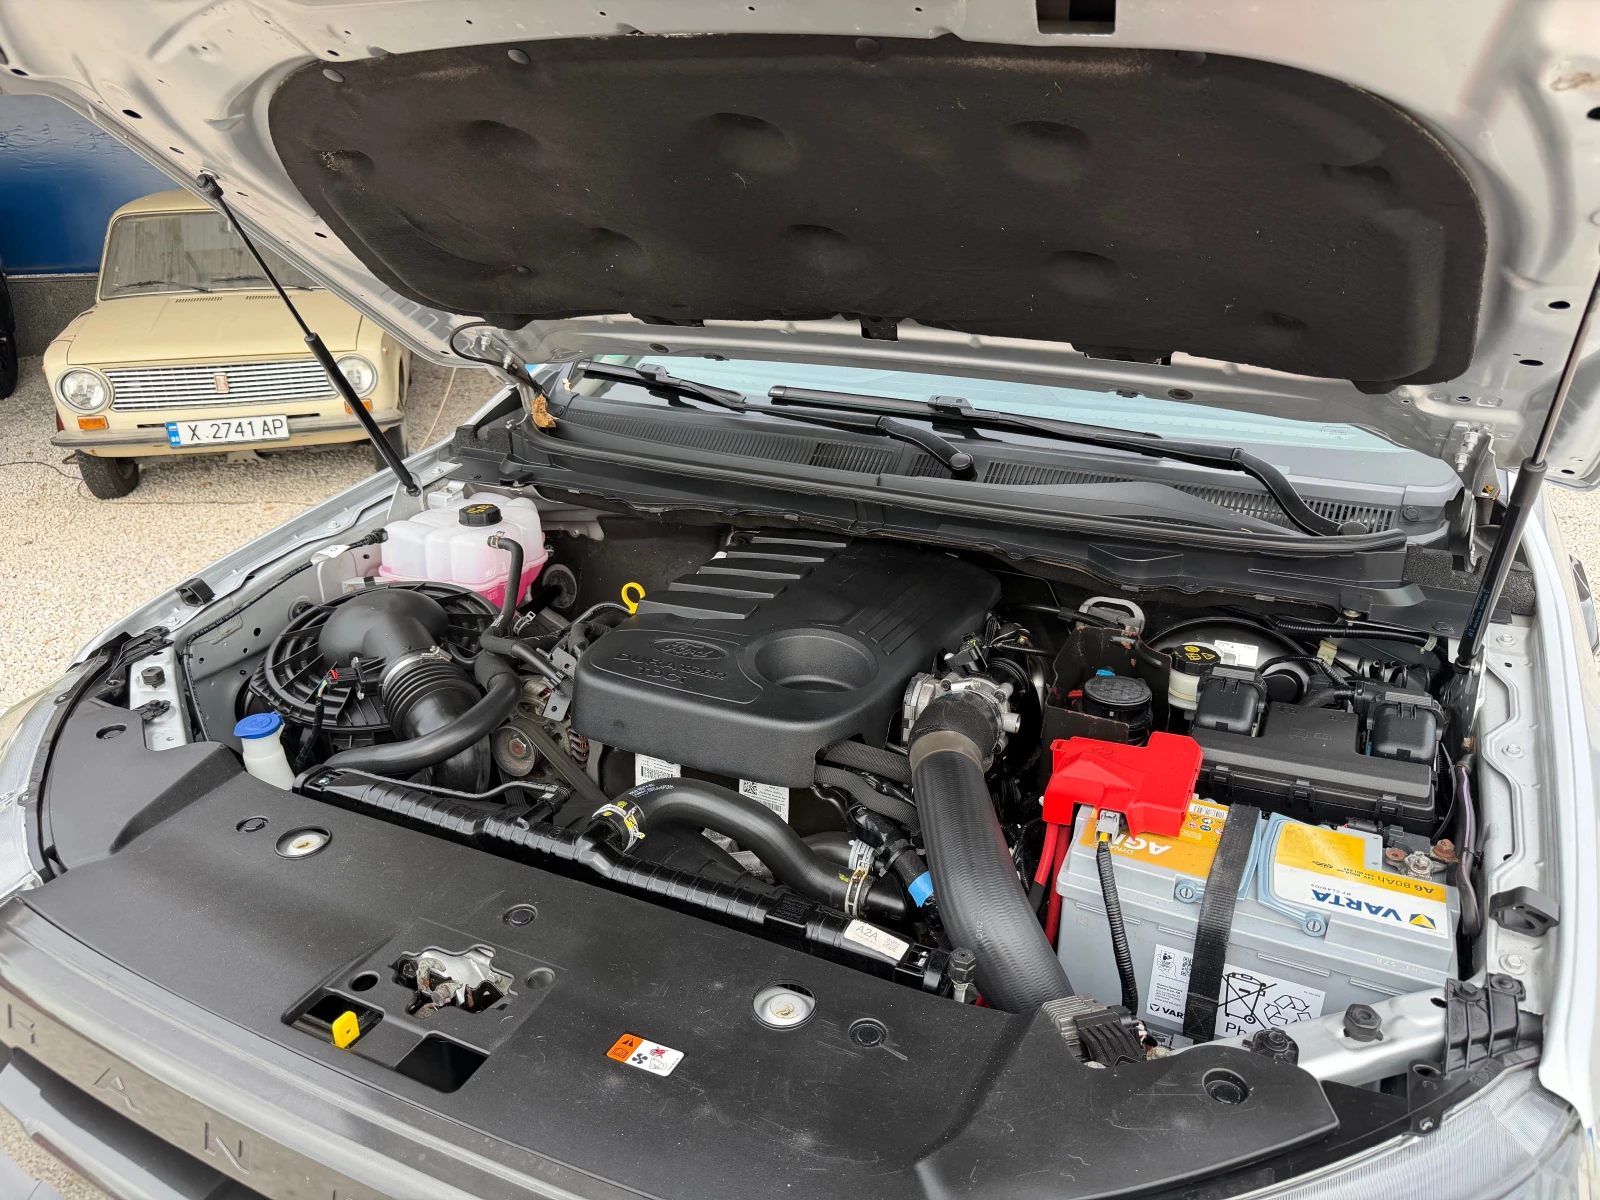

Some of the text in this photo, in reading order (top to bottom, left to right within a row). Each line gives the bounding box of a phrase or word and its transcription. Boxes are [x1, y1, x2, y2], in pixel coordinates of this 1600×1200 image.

[187, 418, 283, 441] X 2741 AP
[1377, 876, 1411, 889] 80Ah
[1413, 884, 1435, 895] A6
[1311, 889, 1404, 923] VARTA
[855, 925, 878, 942] A2A
[1162, 1007, 1185, 1020] VAR
